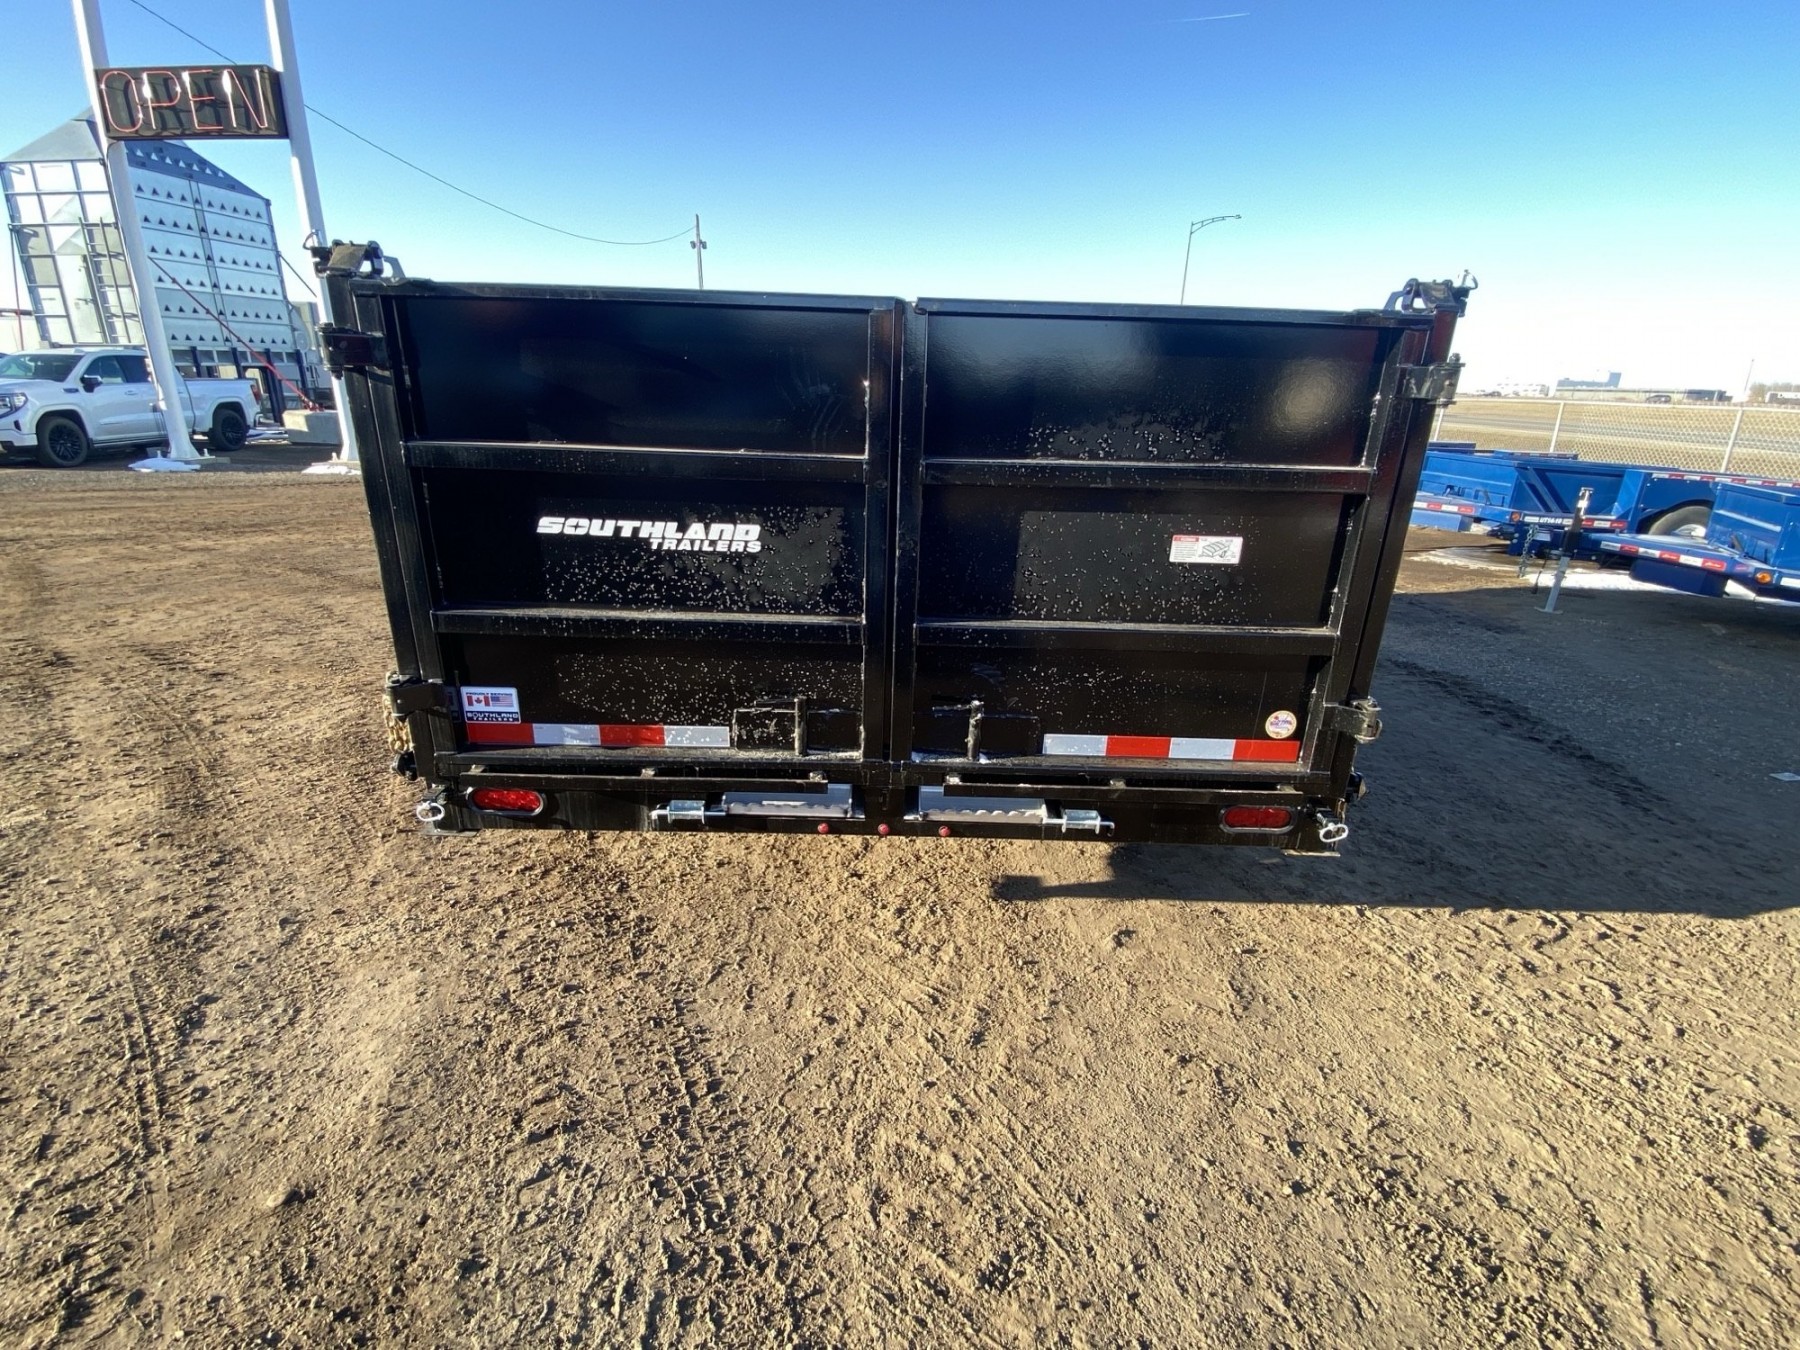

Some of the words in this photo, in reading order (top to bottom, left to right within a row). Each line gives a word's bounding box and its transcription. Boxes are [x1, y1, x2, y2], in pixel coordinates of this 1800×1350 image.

[100, 68, 269, 133] OPEN
[536, 516, 761, 541] SOUTHLAND
[649, 538, 762, 553] TRAILERS
